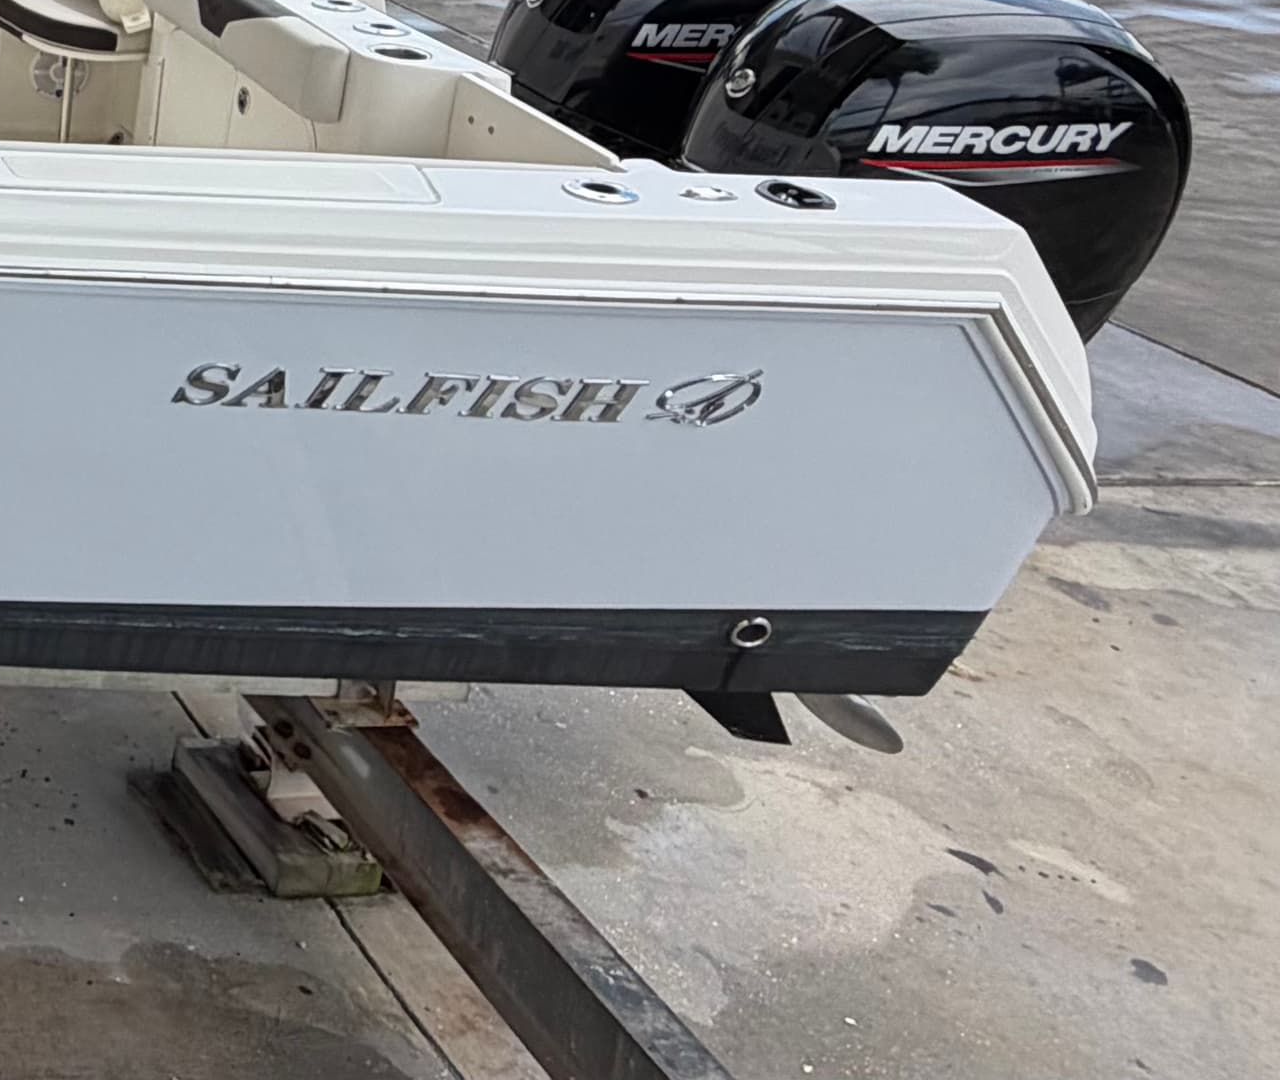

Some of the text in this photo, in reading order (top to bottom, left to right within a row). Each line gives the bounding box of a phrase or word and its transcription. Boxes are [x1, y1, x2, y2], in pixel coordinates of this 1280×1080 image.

[632, 23, 741, 48] MER
[867, 121, 1134, 155] MERCURY
[171, 361, 650, 423] SAILFISH
